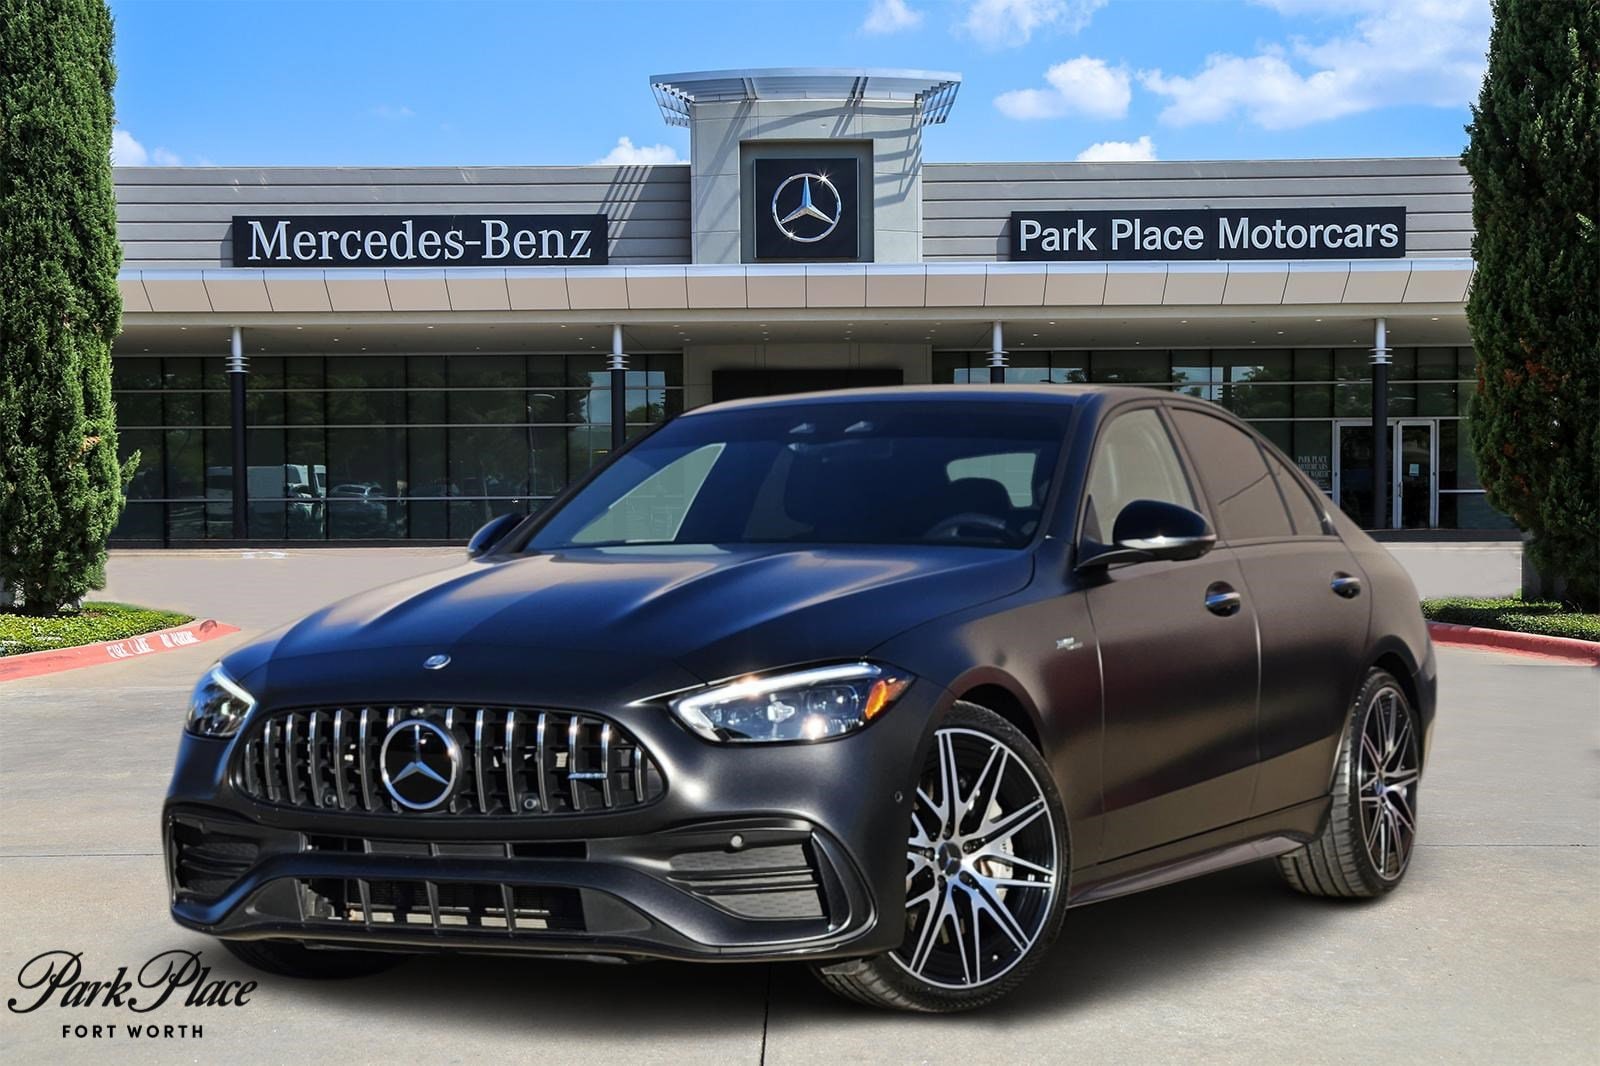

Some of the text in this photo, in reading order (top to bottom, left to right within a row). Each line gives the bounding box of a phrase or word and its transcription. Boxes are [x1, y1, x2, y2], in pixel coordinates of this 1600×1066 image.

[247, 219, 592, 261] Mercedes-Benz
[1019, 216, 1399, 252] Park Place Motorcars
